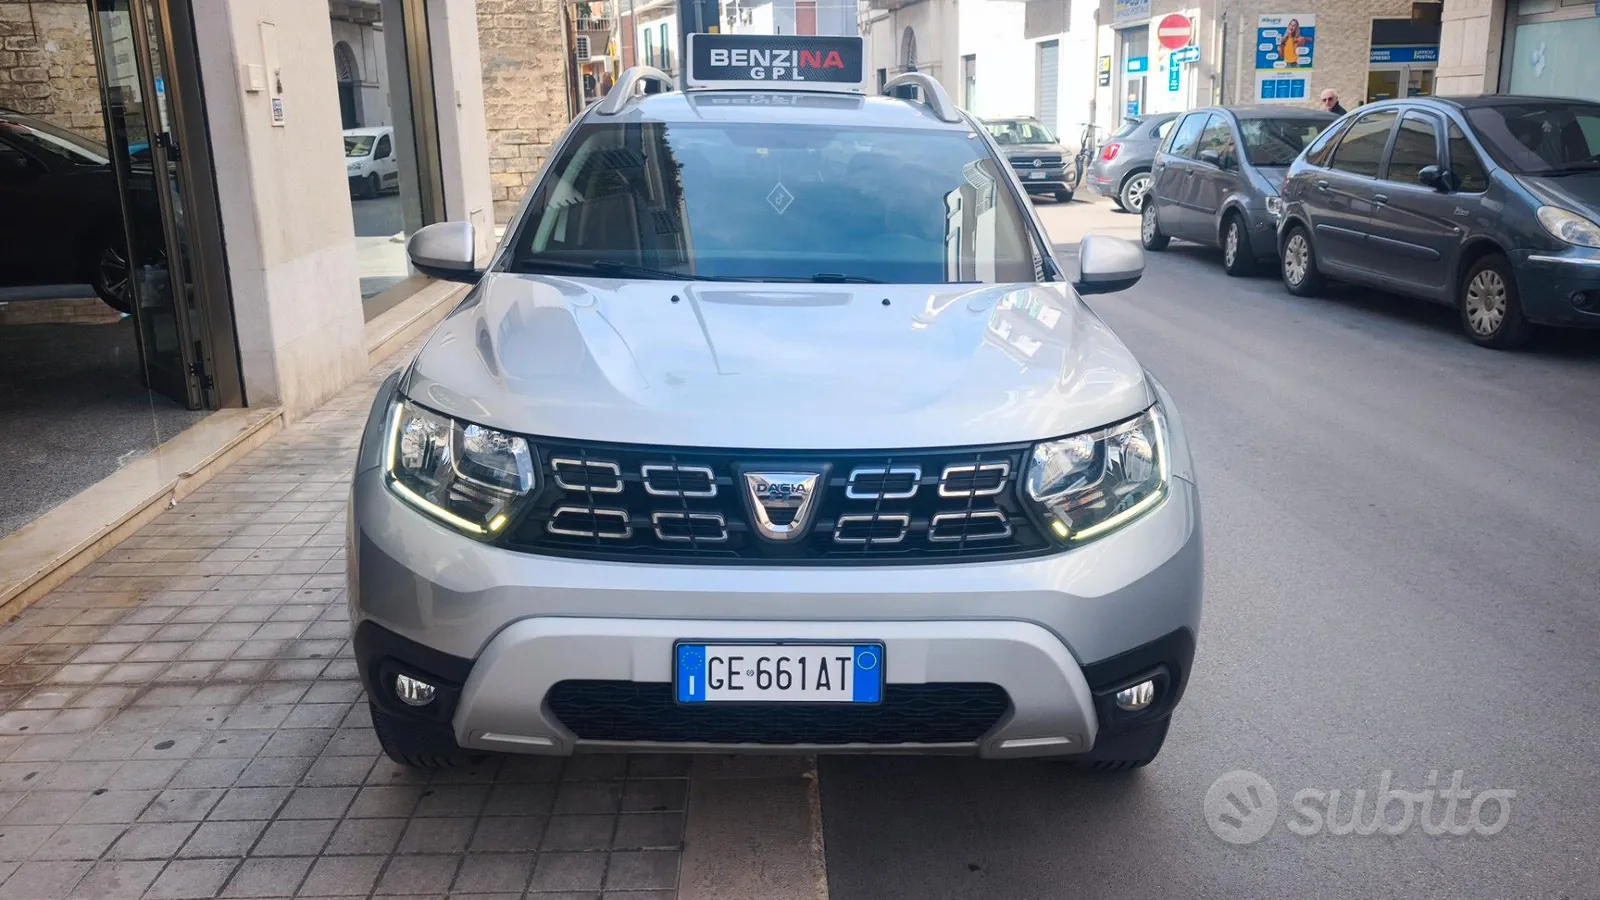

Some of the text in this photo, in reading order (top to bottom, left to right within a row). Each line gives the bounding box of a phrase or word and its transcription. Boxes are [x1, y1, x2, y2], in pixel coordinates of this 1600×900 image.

[710, 49, 844, 69] BENZINA
[750, 67, 805, 80] GPL
[756, 483, 807, 493] DACIA
